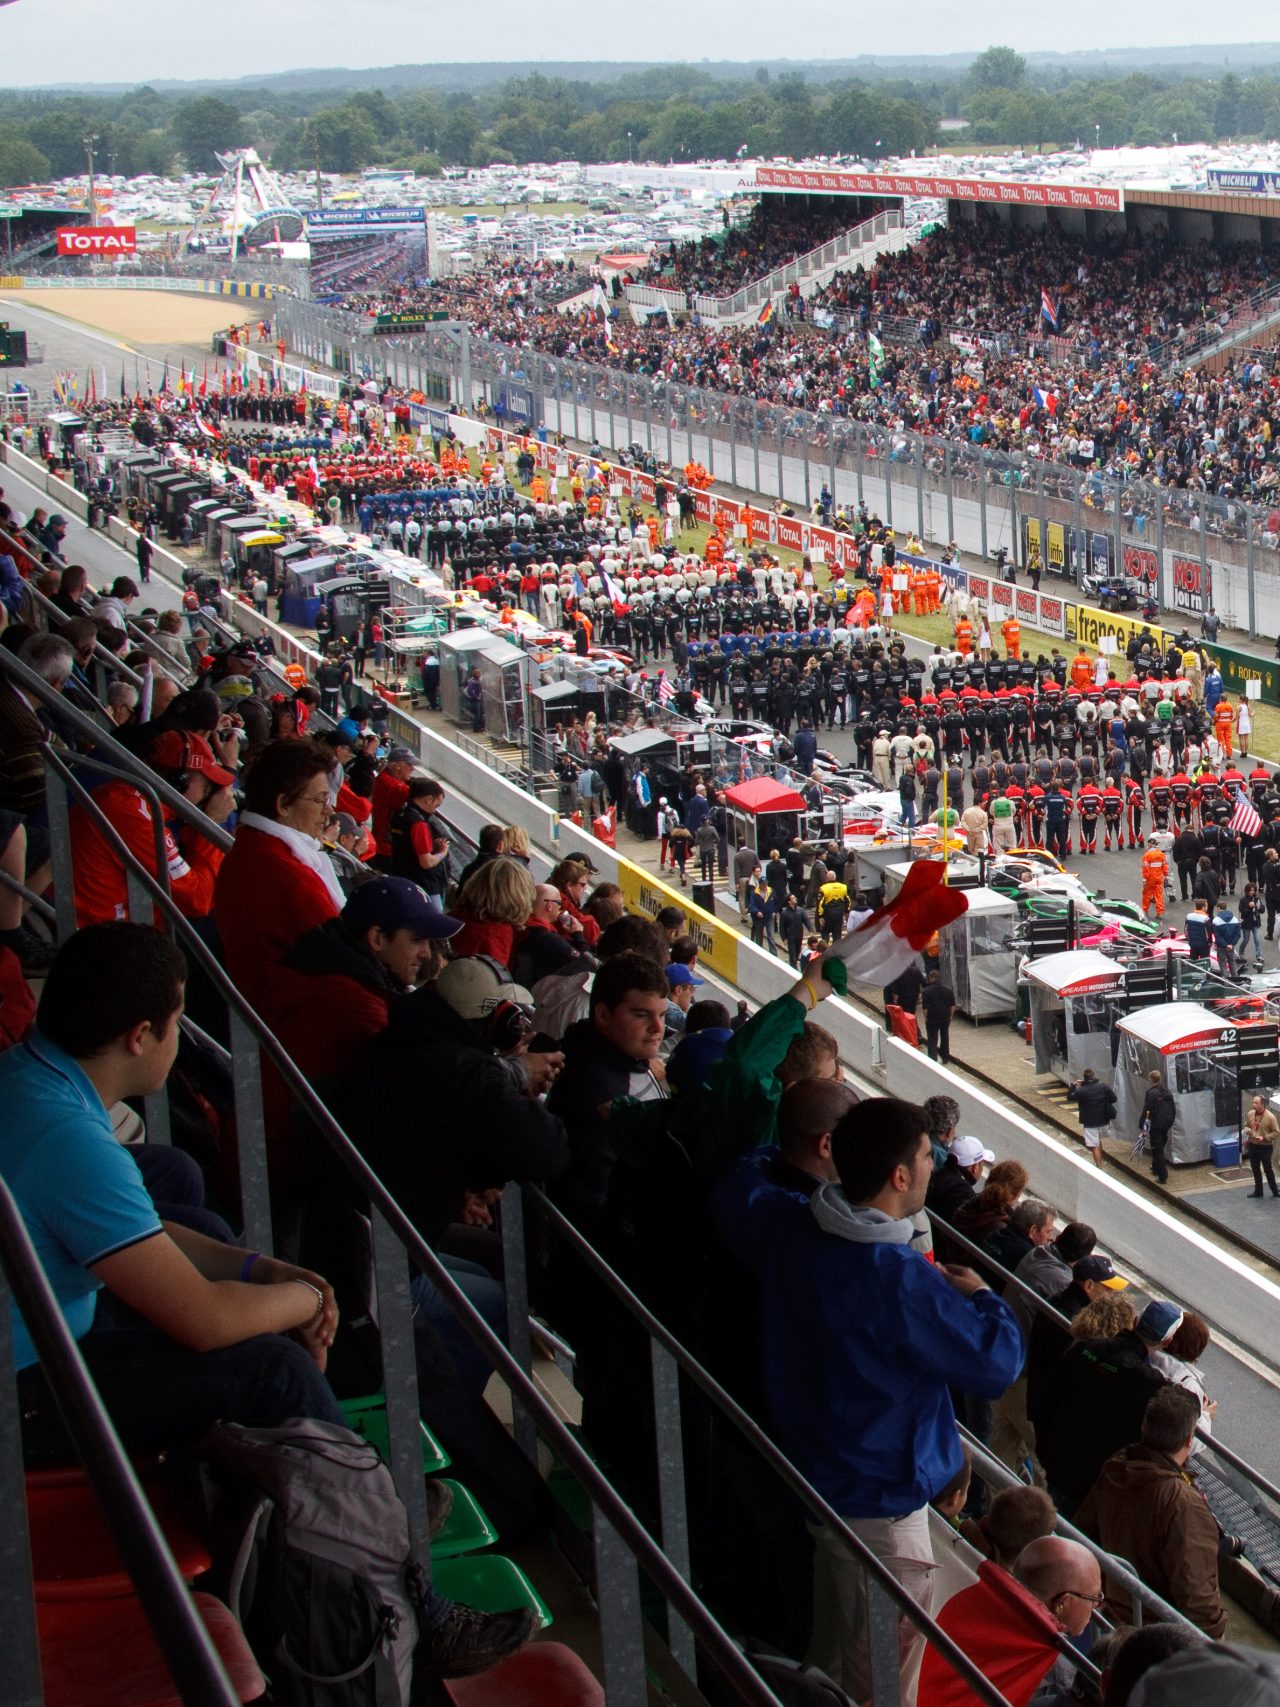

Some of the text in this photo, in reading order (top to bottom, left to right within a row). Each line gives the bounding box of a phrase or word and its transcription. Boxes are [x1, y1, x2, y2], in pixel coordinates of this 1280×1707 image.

[757, 170, 1117, 206] TOTAL TOTAL TOTAL TOTAL TOTAL TOTAL TOTAL TOTAL TOTAL TOTAL TOTAL TOTAL TOTAL TOTAL TOTAL TOTAL TOTAL TOTAL
[1220, 174, 1258, 187] MICHELIN
[60, 233, 134, 249] TOTAL
[614, 472, 631, 490] TOTAL
[752, 518, 768, 533] OTAL
[779, 524, 801, 543] TOTAL
[812, 532, 834, 555] TOTAL
[1050, 543, 1063, 562] info
[1123, 546, 1158, 582] MOTO
[992, 584, 1012, 606] MOTO
[1016, 591, 1036, 613] MOTO
[1041, 598, 1061, 620] MOTO
[1079, 608, 1125, 648] france
[1238, 666, 1262, 681] ROLEX
[714, 724, 732, 733] AN
[689, 918, 713, 955] Nikon
[1062, 986, 1088, 994] GREAVES
[1089, 982, 1117, 991] MOTORSPORT
[1194, 1039, 1218, 1047] MOTORSPORT
[1220, 1030, 1236, 1042] 42
